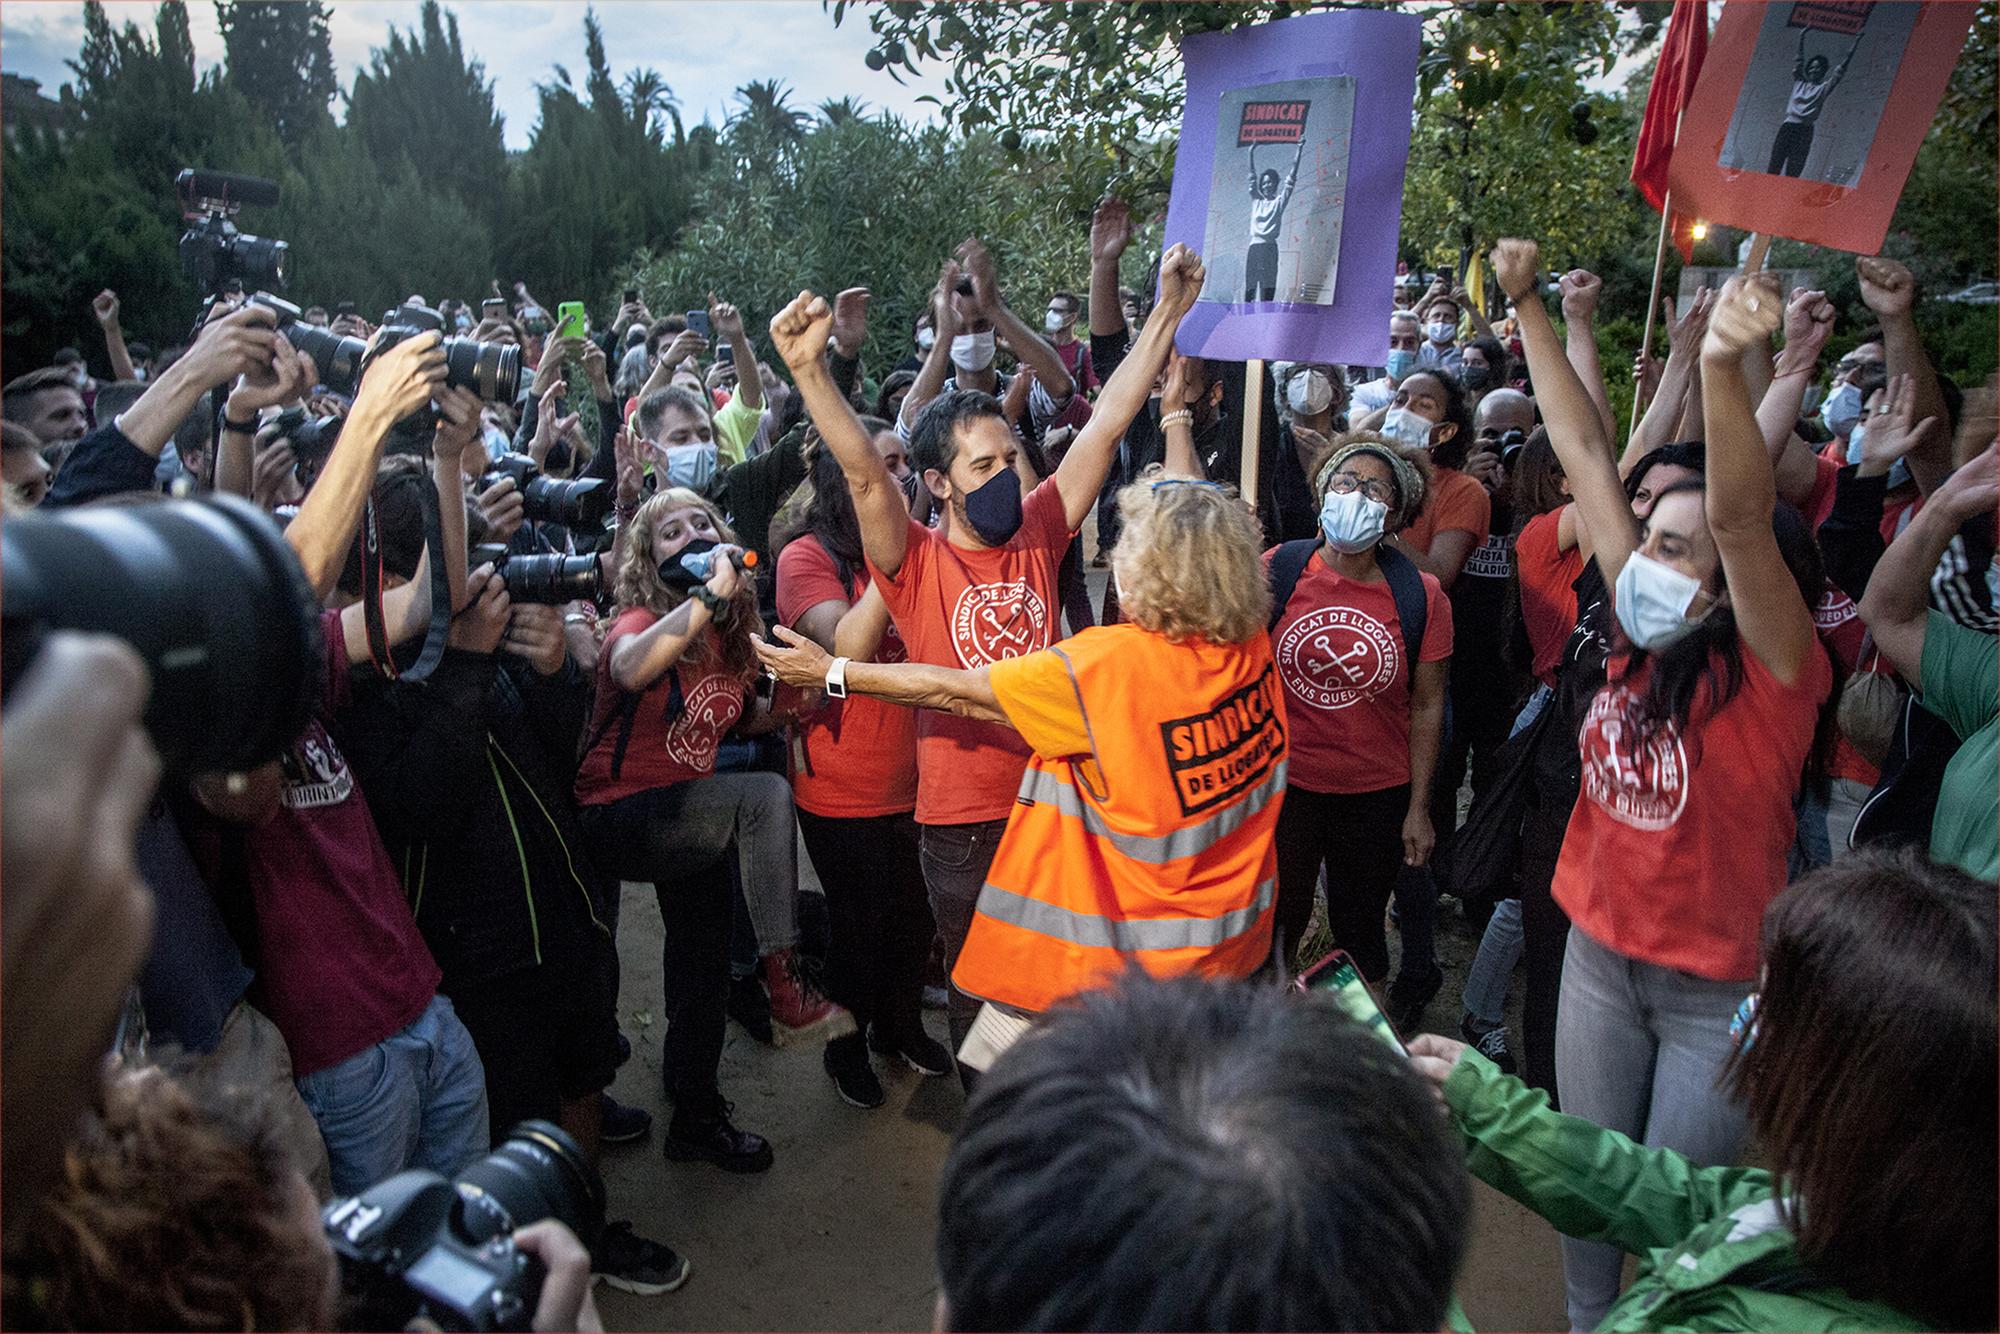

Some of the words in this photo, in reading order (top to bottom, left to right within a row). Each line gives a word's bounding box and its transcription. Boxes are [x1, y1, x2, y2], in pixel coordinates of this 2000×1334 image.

[1245, 103, 1305, 120] SINDICAT
[1467, 560, 1508, 576] SALARIO
[981, 589, 999, 601] DE
[1282, 614, 1323, 664] SINDICAT
[1329, 612, 1347, 624] DE
[1351, 614, 1394, 683] LLOGATERES
[706, 680, 718, 693] DE
[1292, 677, 1316, 700] ENS
[1189, 774, 1214, 795] DE
